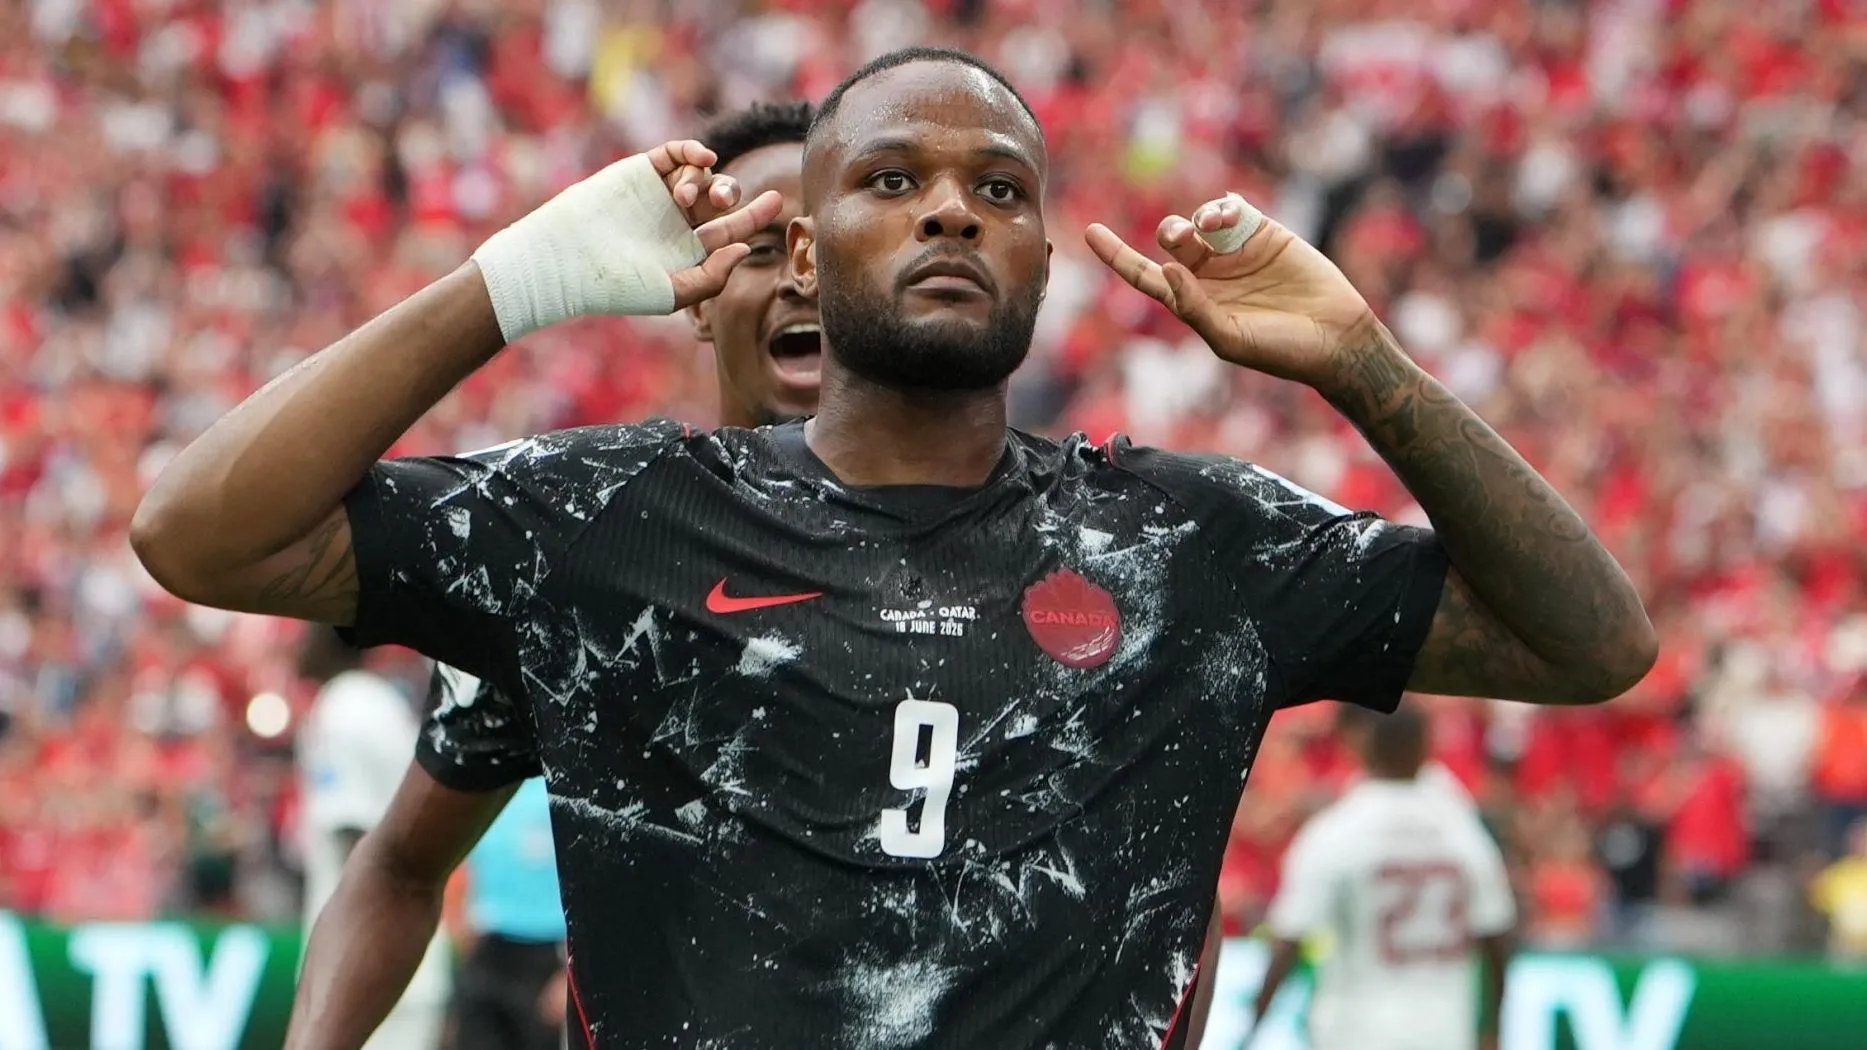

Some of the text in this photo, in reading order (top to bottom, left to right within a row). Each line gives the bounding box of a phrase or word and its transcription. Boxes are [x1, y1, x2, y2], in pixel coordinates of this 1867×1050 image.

[880, 609, 926, 621] CANADA
[939, 606, 976, 620] QATAR
[1029, 610, 1115, 628] CANADA
[910, 620, 935, 634] JUNE
[940, 621, 963, 636] 2026
[881, 699, 959, 858] 9
[67, 920, 271, 1050] TV
